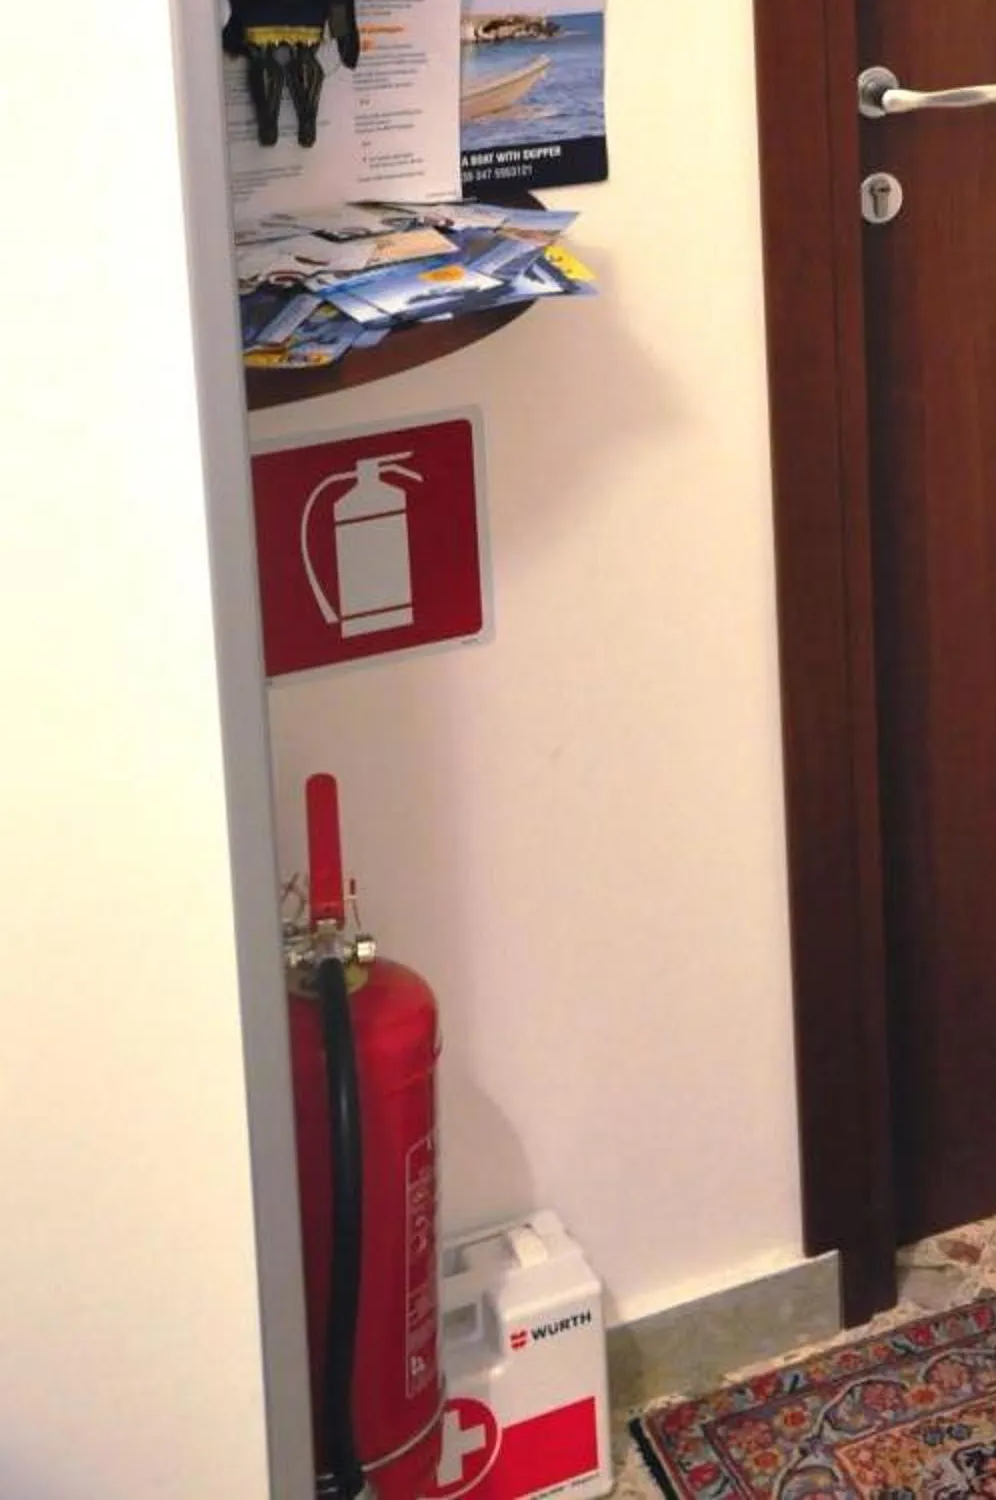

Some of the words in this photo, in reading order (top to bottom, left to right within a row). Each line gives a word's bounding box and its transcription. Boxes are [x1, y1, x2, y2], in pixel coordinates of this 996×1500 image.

[470, 152, 495, 167] BOAT
[495, 150, 520, 163] WITH
[522, 145, 561, 160] SKIPPER
